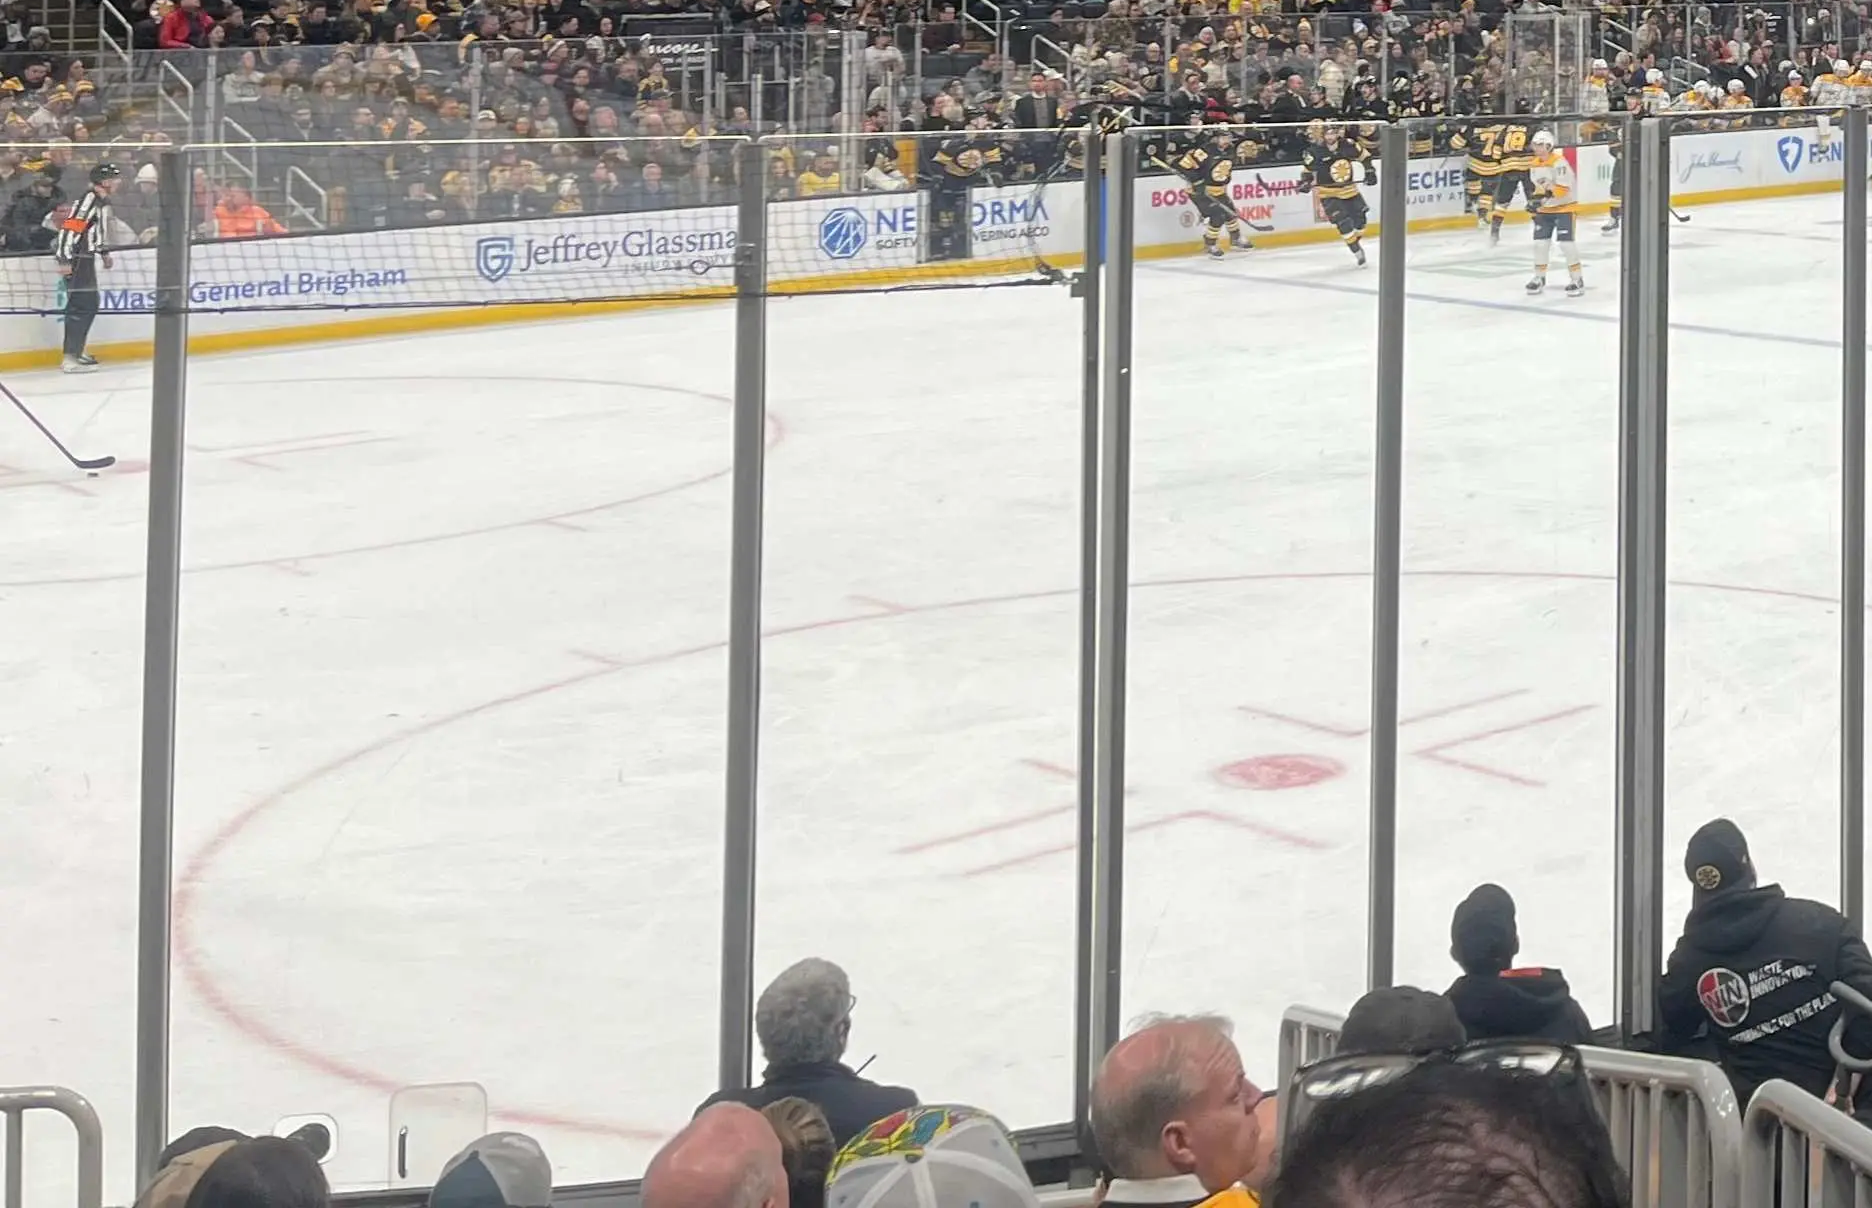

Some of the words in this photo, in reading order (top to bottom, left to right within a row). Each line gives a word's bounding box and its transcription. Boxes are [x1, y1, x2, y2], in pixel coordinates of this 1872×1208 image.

[1151, 190, 1190, 208] BOS
[519, 235, 620, 272] Jeffrey
[622, 229, 739, 258] Glassma
[104, 288, 158, 311] Mas
[191, 275, 290, 304] General
[298, 267, 407, 295] Brigham
[1748, 960, 1783, 985] WASTE
